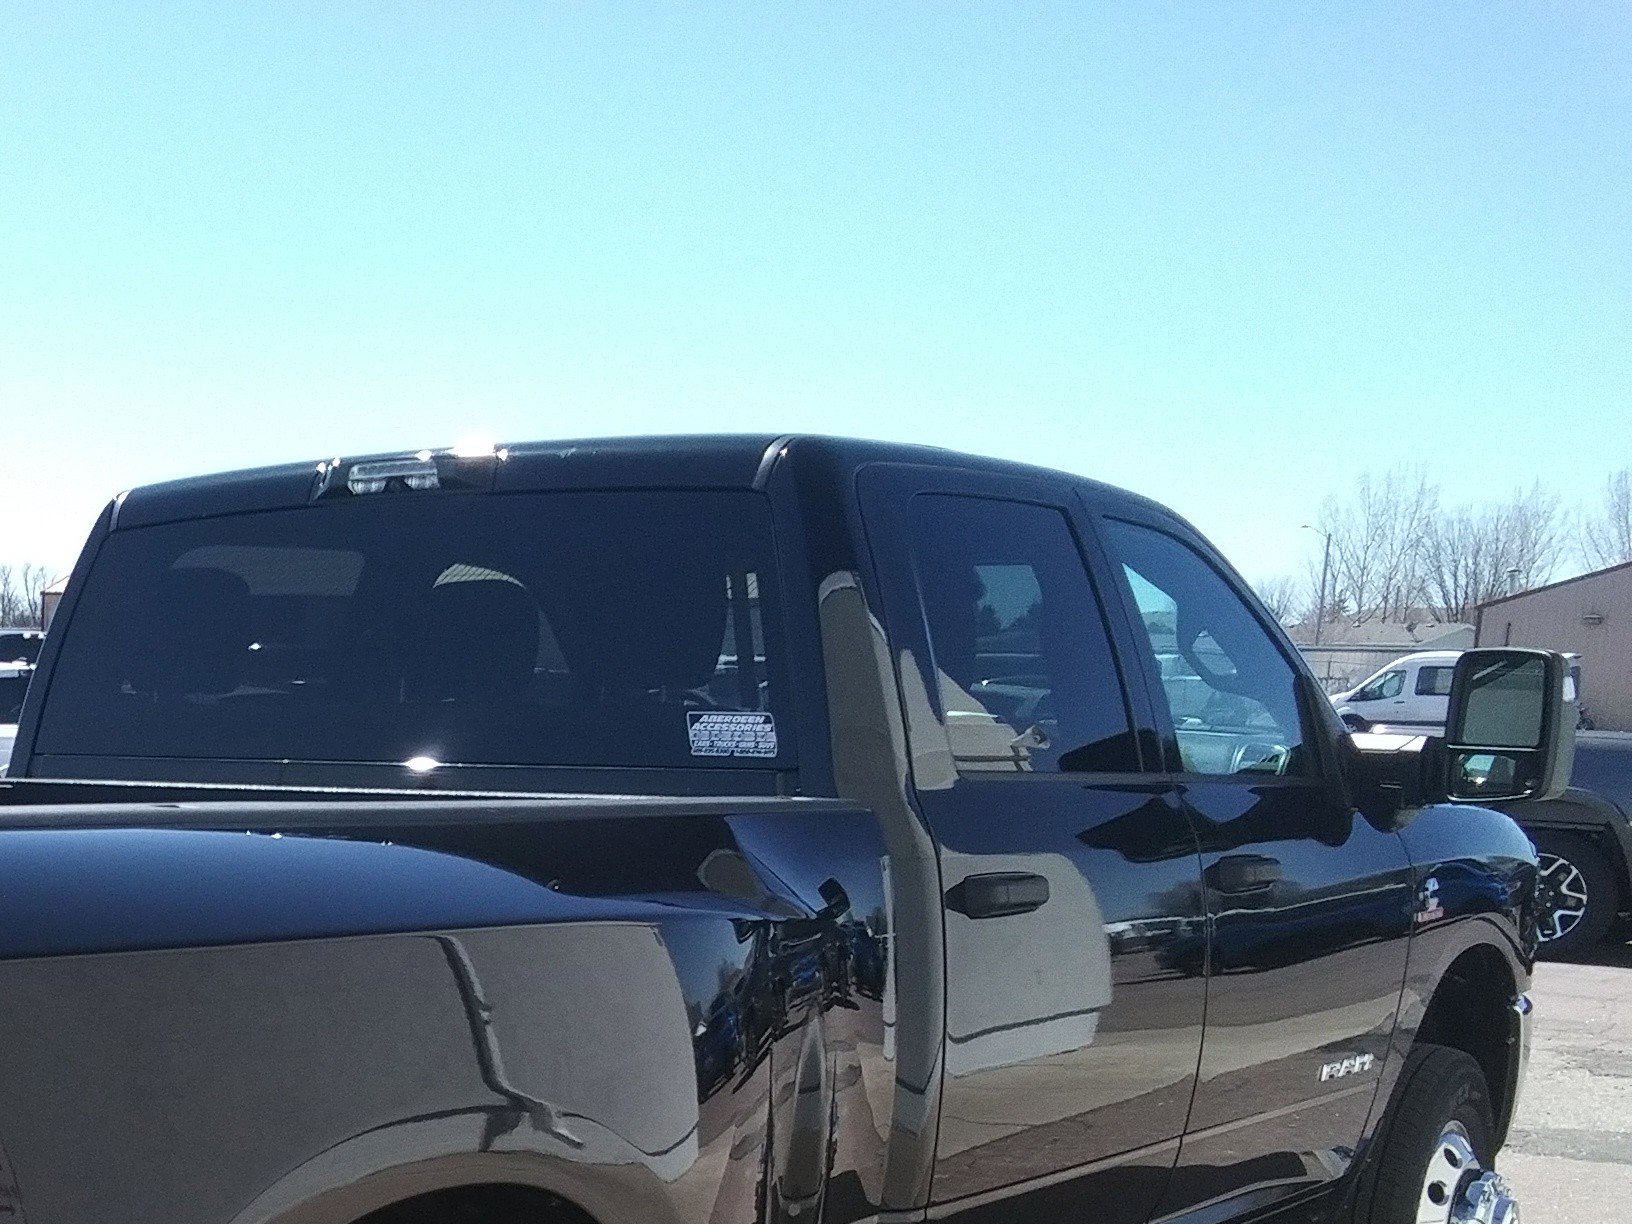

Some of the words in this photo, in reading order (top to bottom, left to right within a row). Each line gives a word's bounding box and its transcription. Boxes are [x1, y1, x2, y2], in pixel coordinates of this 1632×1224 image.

[699, 715, 766, 724] ABERDEEN
[690, 723, 773, 732] ACCESSORIES
[1320, 1053, 1374, 1081] RAM
